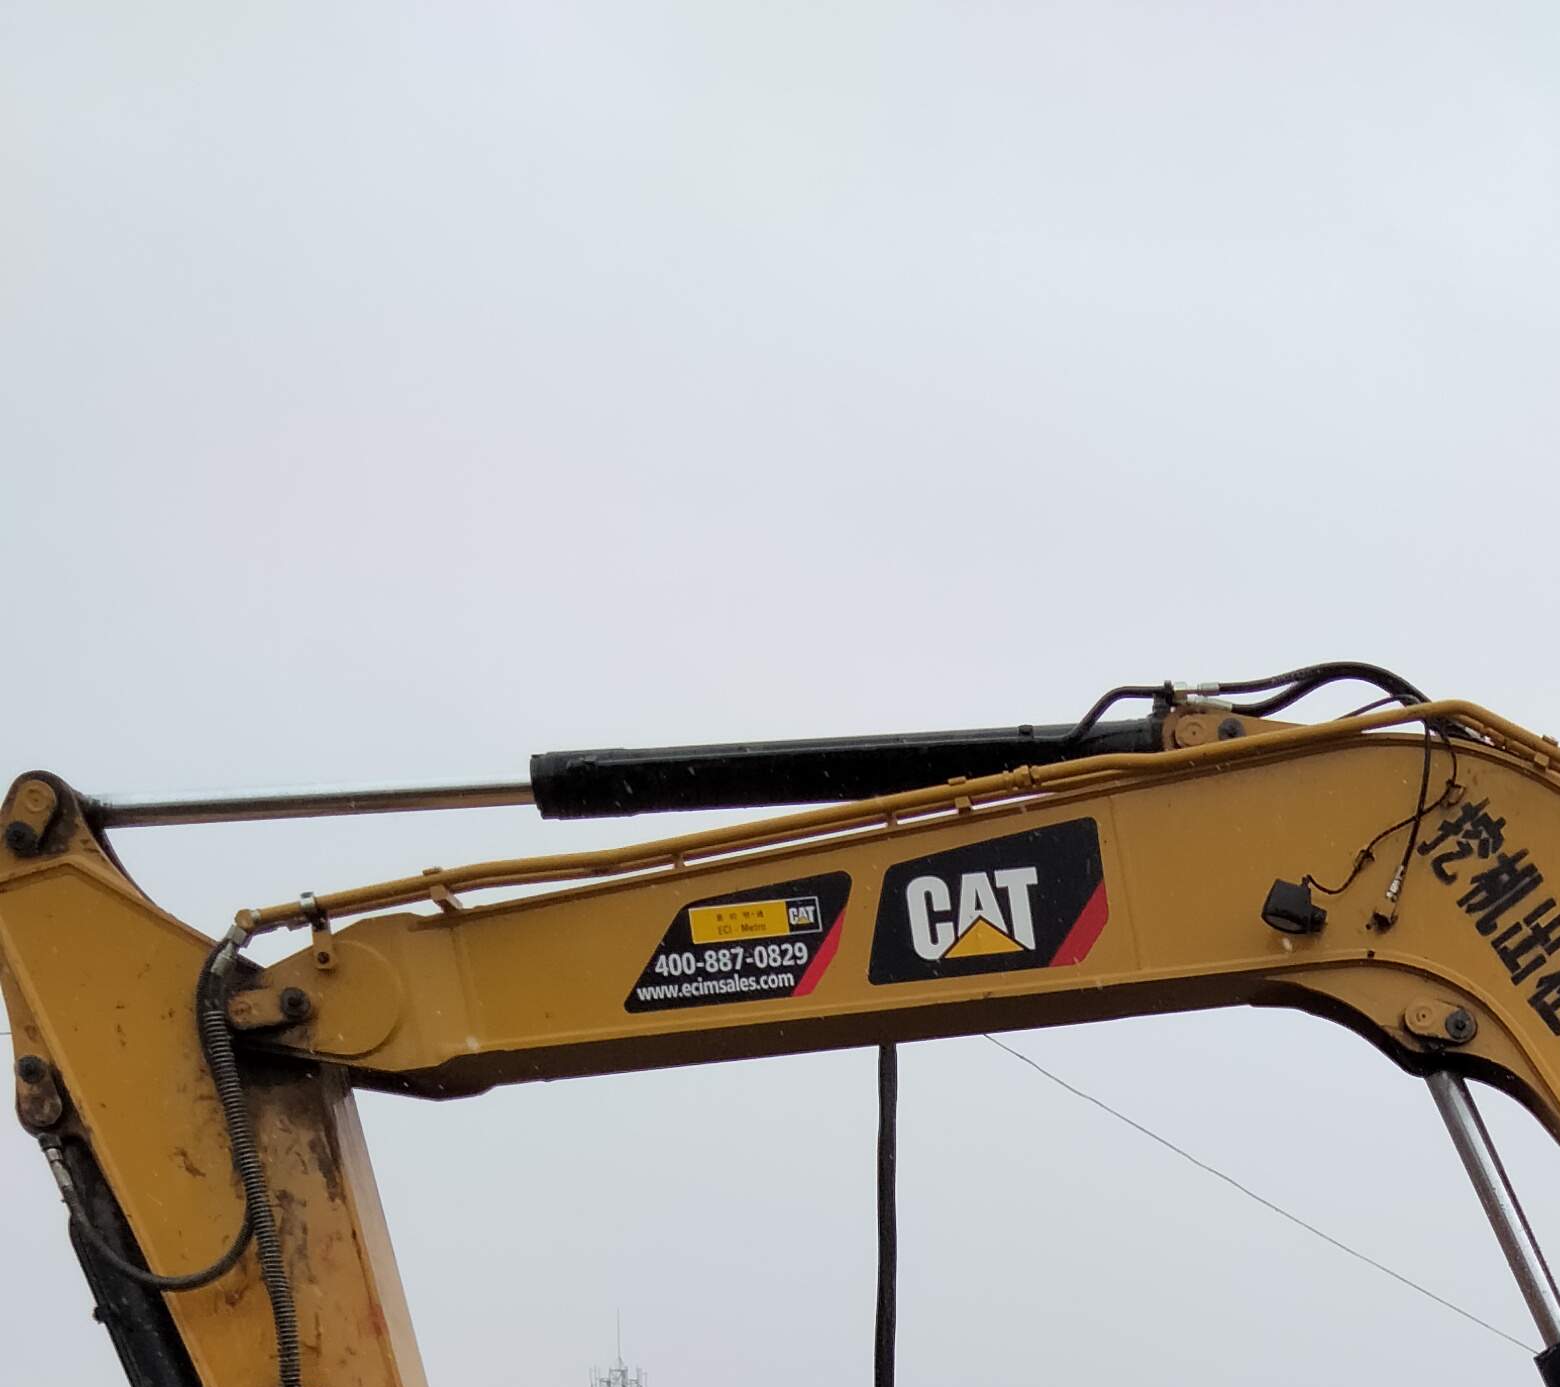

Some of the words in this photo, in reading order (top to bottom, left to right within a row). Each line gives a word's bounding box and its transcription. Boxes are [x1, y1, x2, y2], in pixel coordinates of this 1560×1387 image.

[788, 906, 816, 925] CAT
[906, 867, 1039, 960] CAT
[655, 941, 809, 977] 400-887-0829
[637, 971, 795, 1001] www.ecimsales.com
